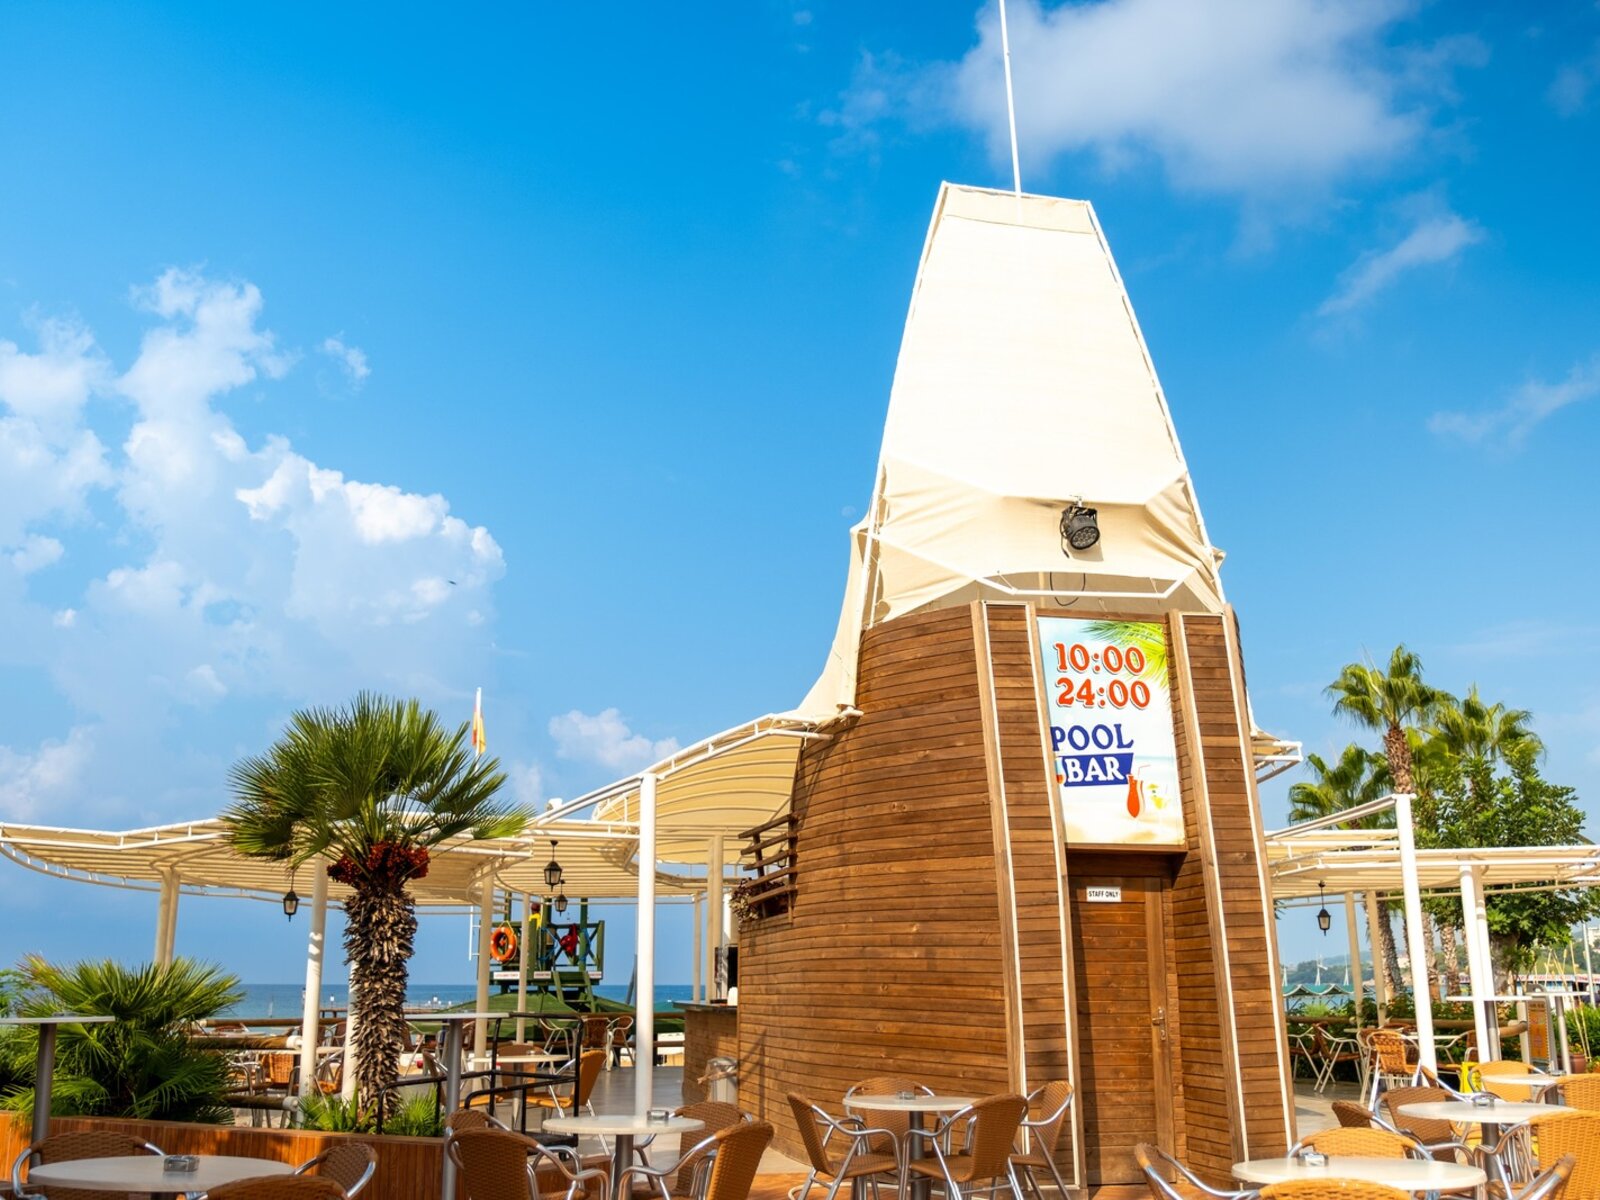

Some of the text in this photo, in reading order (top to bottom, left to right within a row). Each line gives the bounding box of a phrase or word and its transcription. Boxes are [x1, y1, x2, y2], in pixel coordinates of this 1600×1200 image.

[1054, 643, 1145, 674] 10:00
[1056, 677, 1151, 709] 24:00
[1050, 723, 1134, 751] POOL
[1064, 756, 1125, 782] BAR
[1088, 890, 1119, 899] STAFF ONLY
